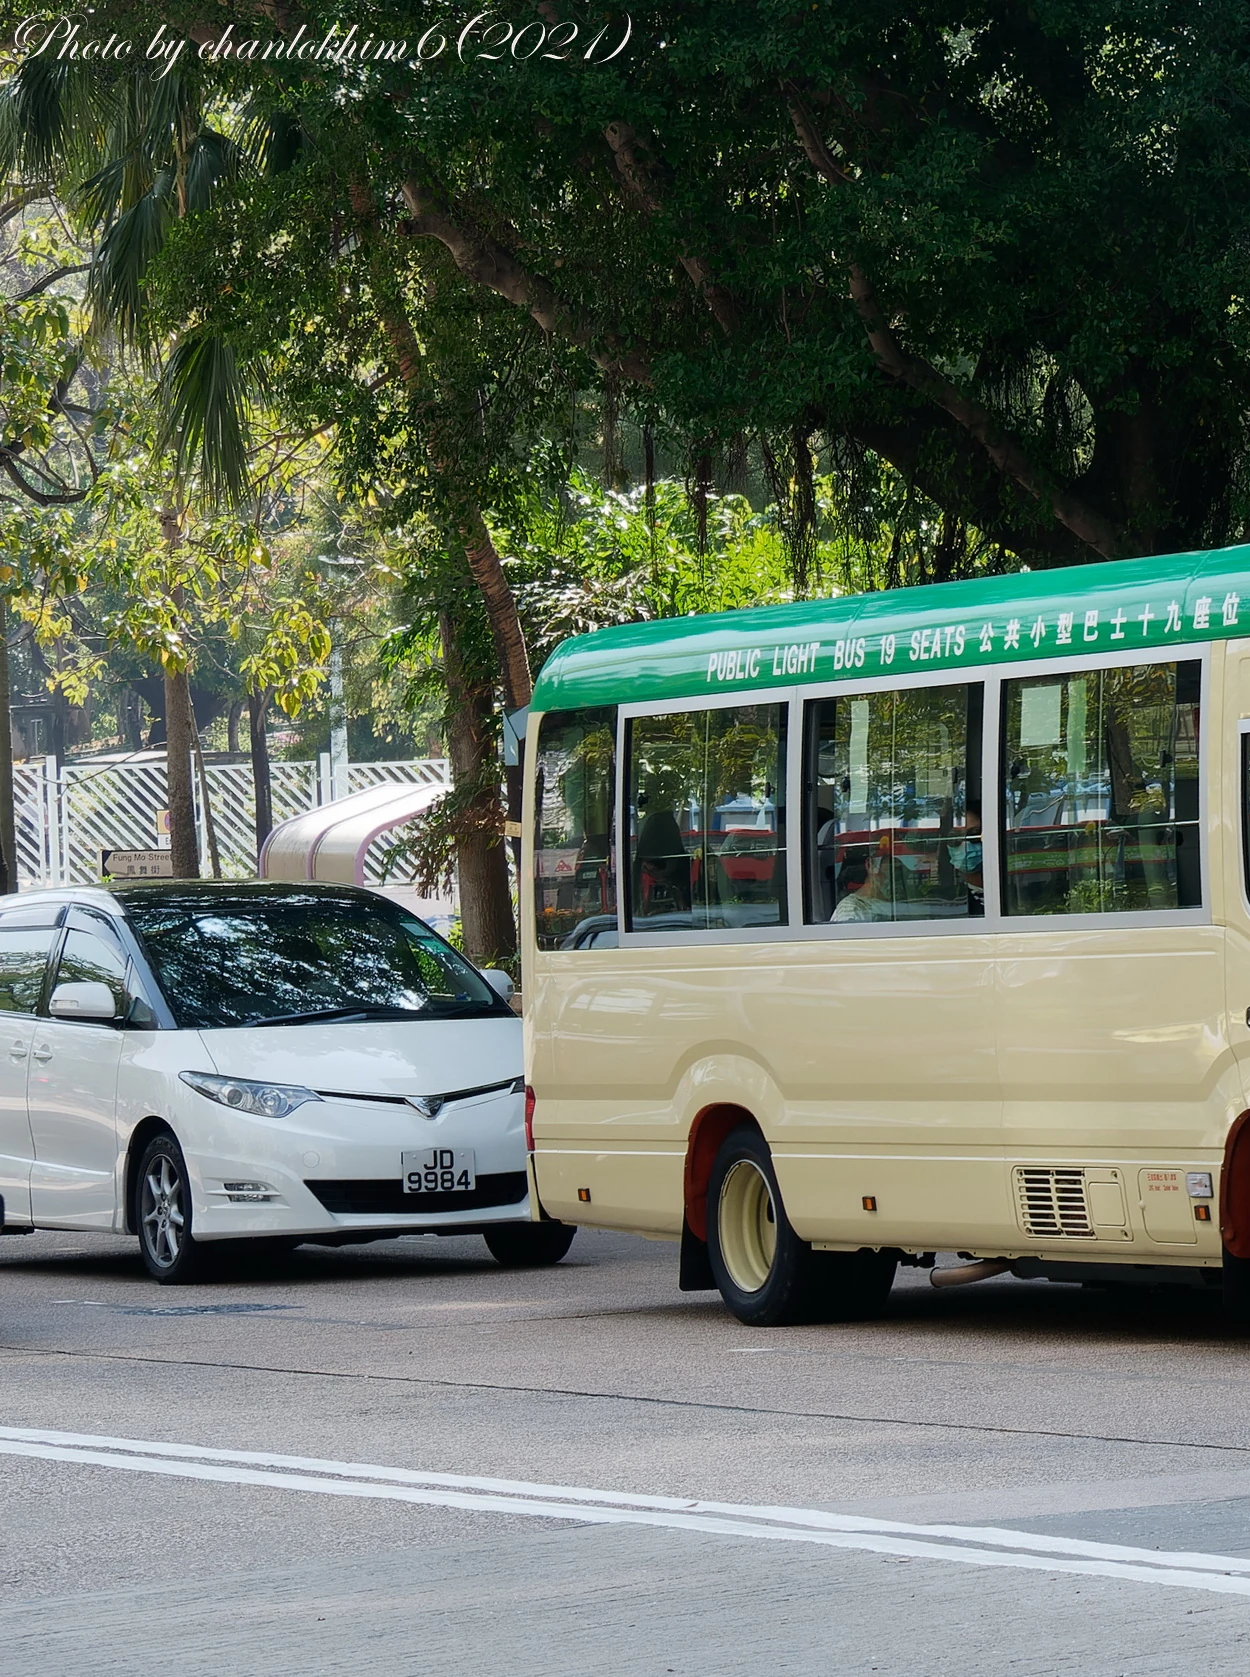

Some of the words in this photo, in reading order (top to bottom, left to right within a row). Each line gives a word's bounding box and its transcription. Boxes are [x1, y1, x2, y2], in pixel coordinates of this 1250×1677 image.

[978, 592, 1241, 653] 公共小型巴士十九座位
[706, 649, 761, 682] PUBLIC
[772, 642, 820, 676] LIGHT
[833, 638, 866, 671] BUS
[879, 634, 896, 665] 19
[909, 625, 966, 661] SEATS
[112, 853, 132, 862] Fung
[148, 853, 171, 861] Stree
[423, 1149, 454, 1170] JD
[407, 1169, 471, 1192] 9984
